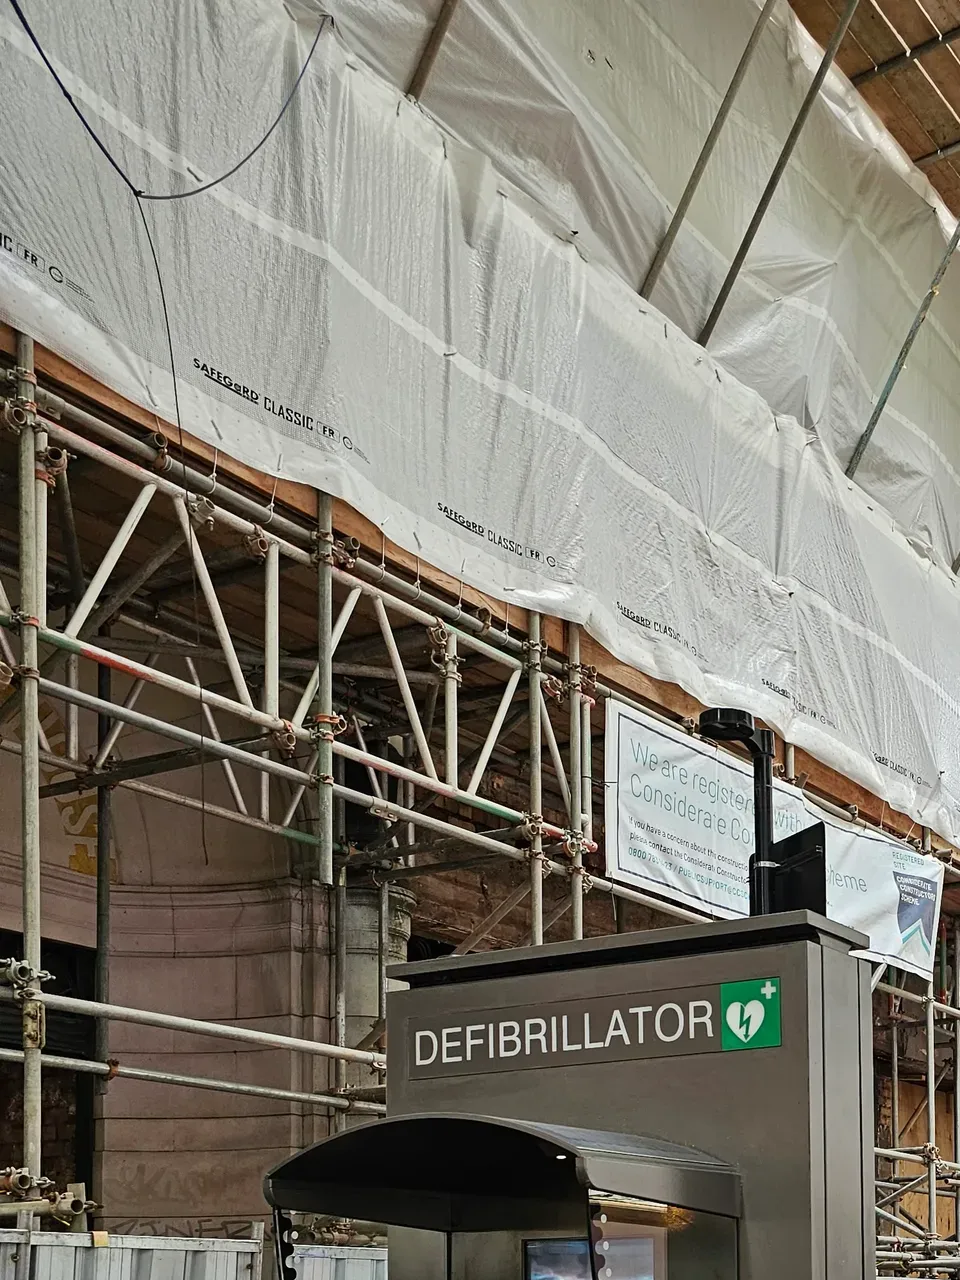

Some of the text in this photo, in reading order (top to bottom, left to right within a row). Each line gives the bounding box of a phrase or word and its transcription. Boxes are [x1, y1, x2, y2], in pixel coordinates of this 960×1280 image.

[264, 396, 314, 431] CLASSIC
[322, 426, 335, 438] FR
[488, 530, 523, 556] CLASSIC
[630, 738, 658, 771] We
[661, 761, 688, 785] are
[630, 774, 726, 836] Considerate
[634, 820, 646, 831] you
[646, 823, 661, 836] have
[648, 841, 673, 856] contact
[414, 1000, 715, 1067] DEFIBRILLATOR
